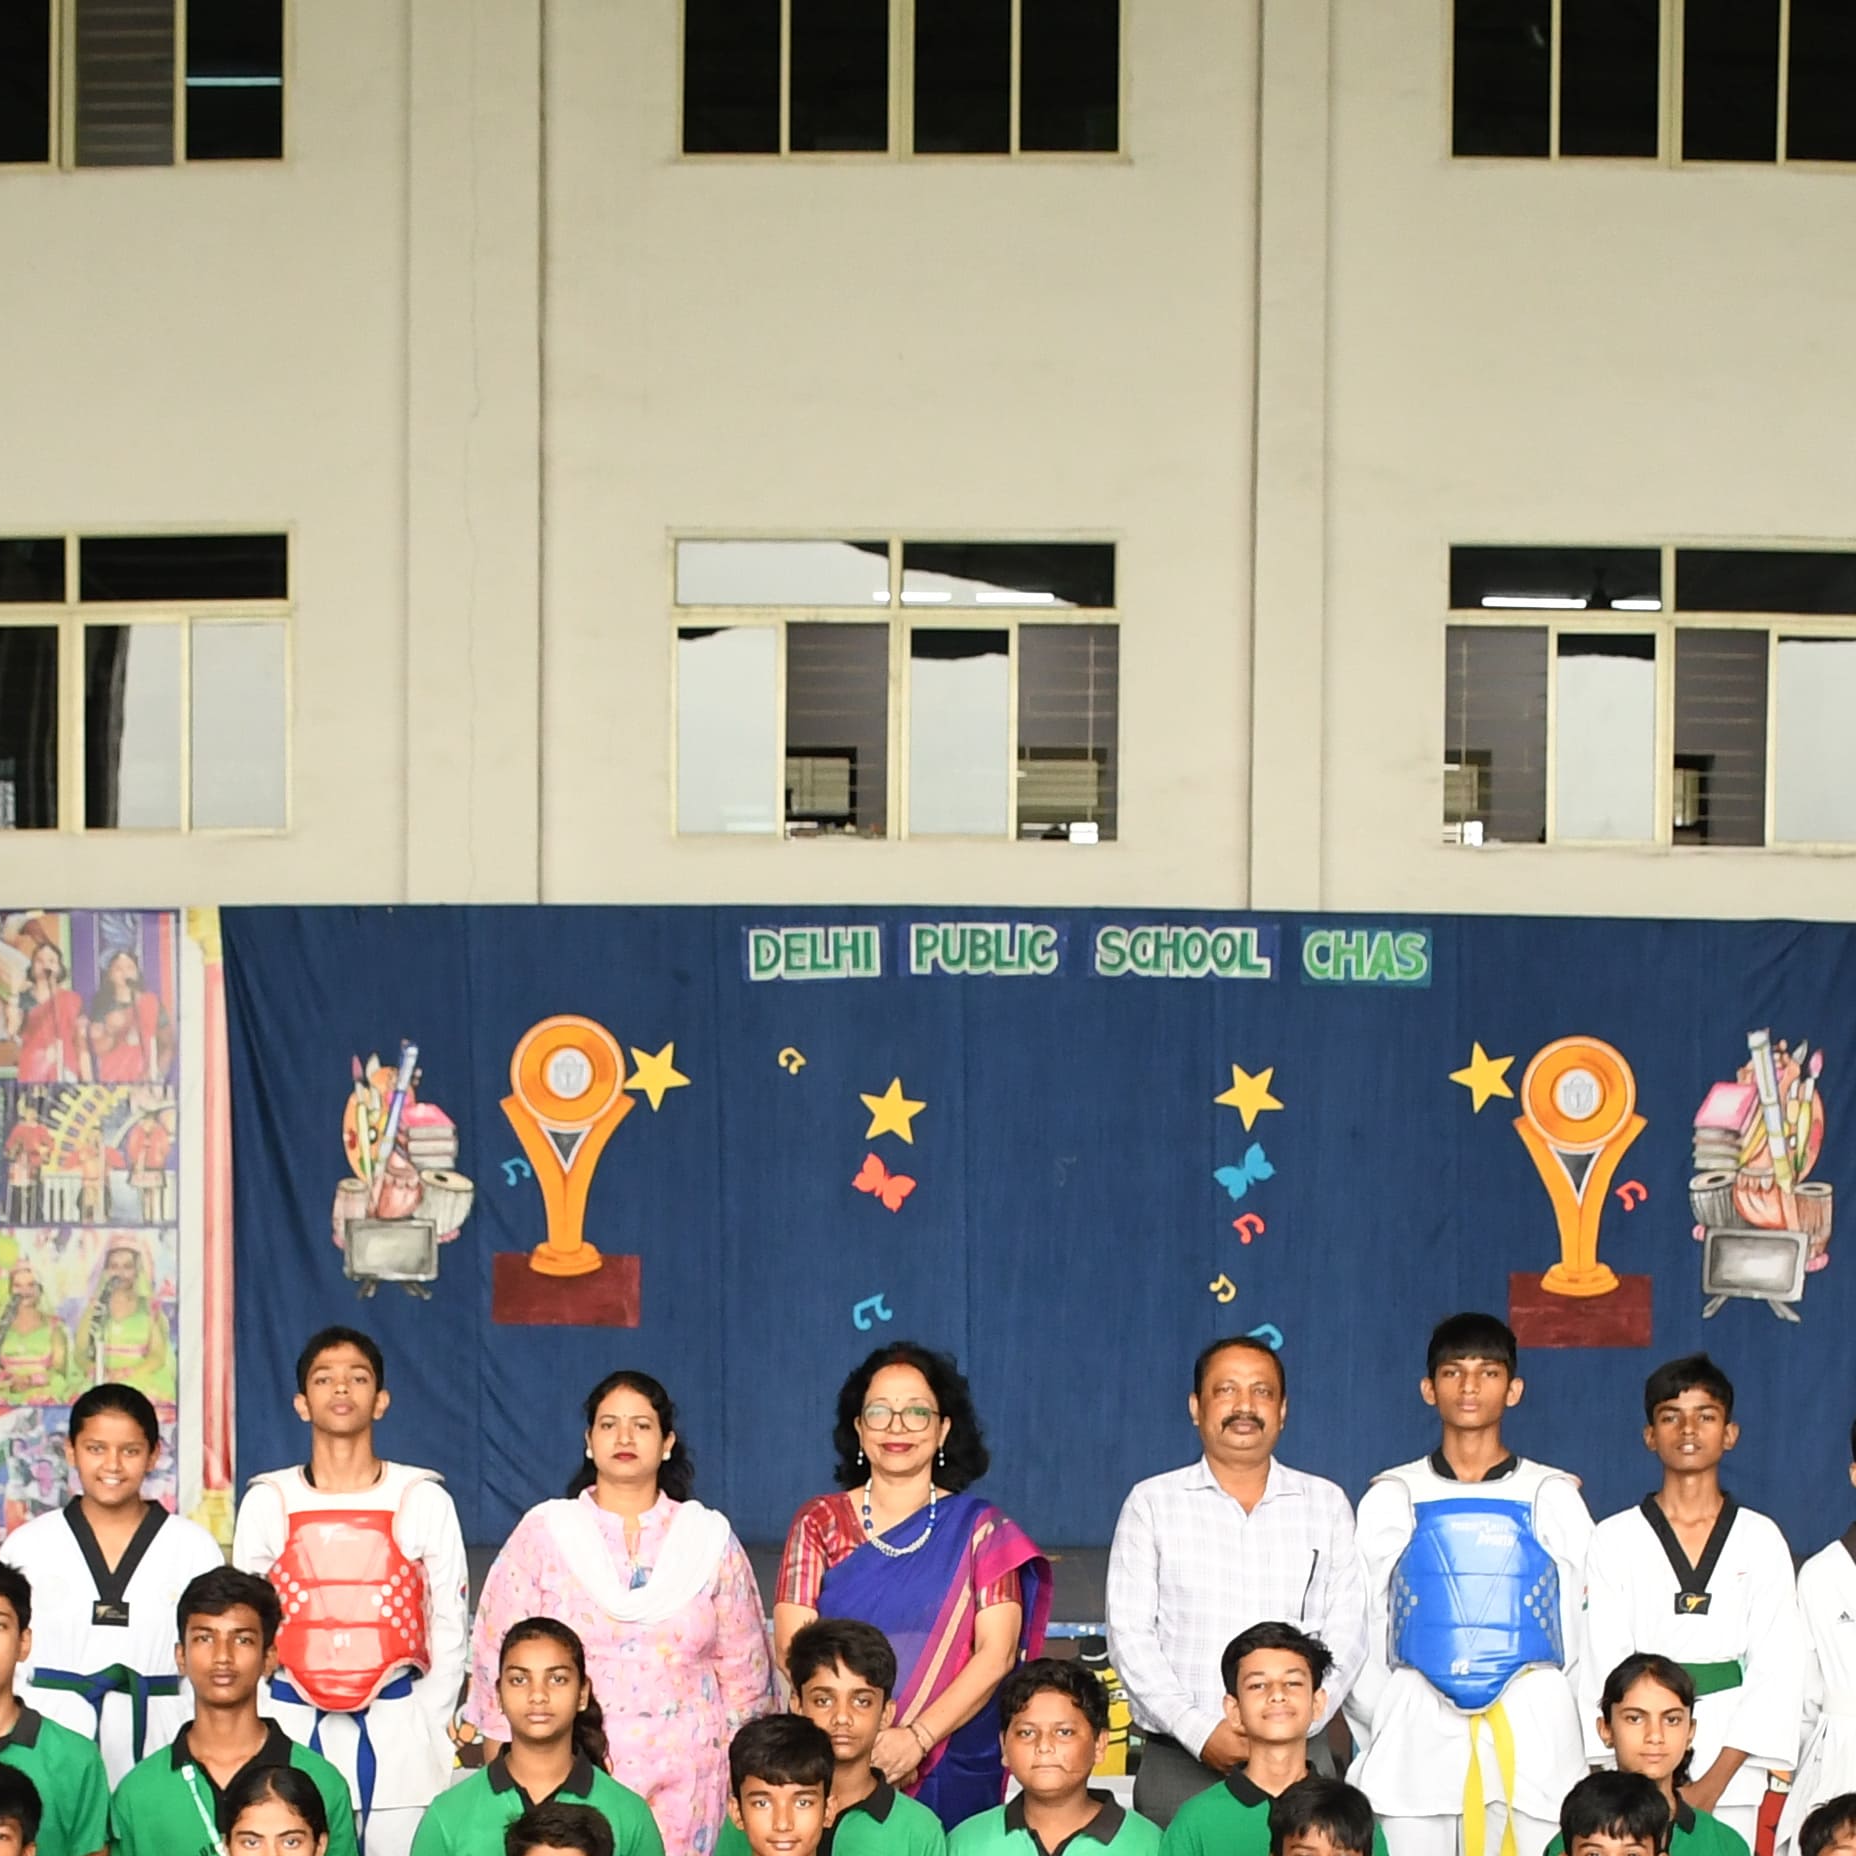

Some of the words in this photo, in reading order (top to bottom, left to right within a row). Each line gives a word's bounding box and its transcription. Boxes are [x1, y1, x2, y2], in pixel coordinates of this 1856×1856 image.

[750, 927, 880, 980] DELHI
[910, 924, 1057, 976] PUBLIC
[1095, 927, 1270, 979] SCHOOL
[1303, 931, 1427, 980] CHAS
